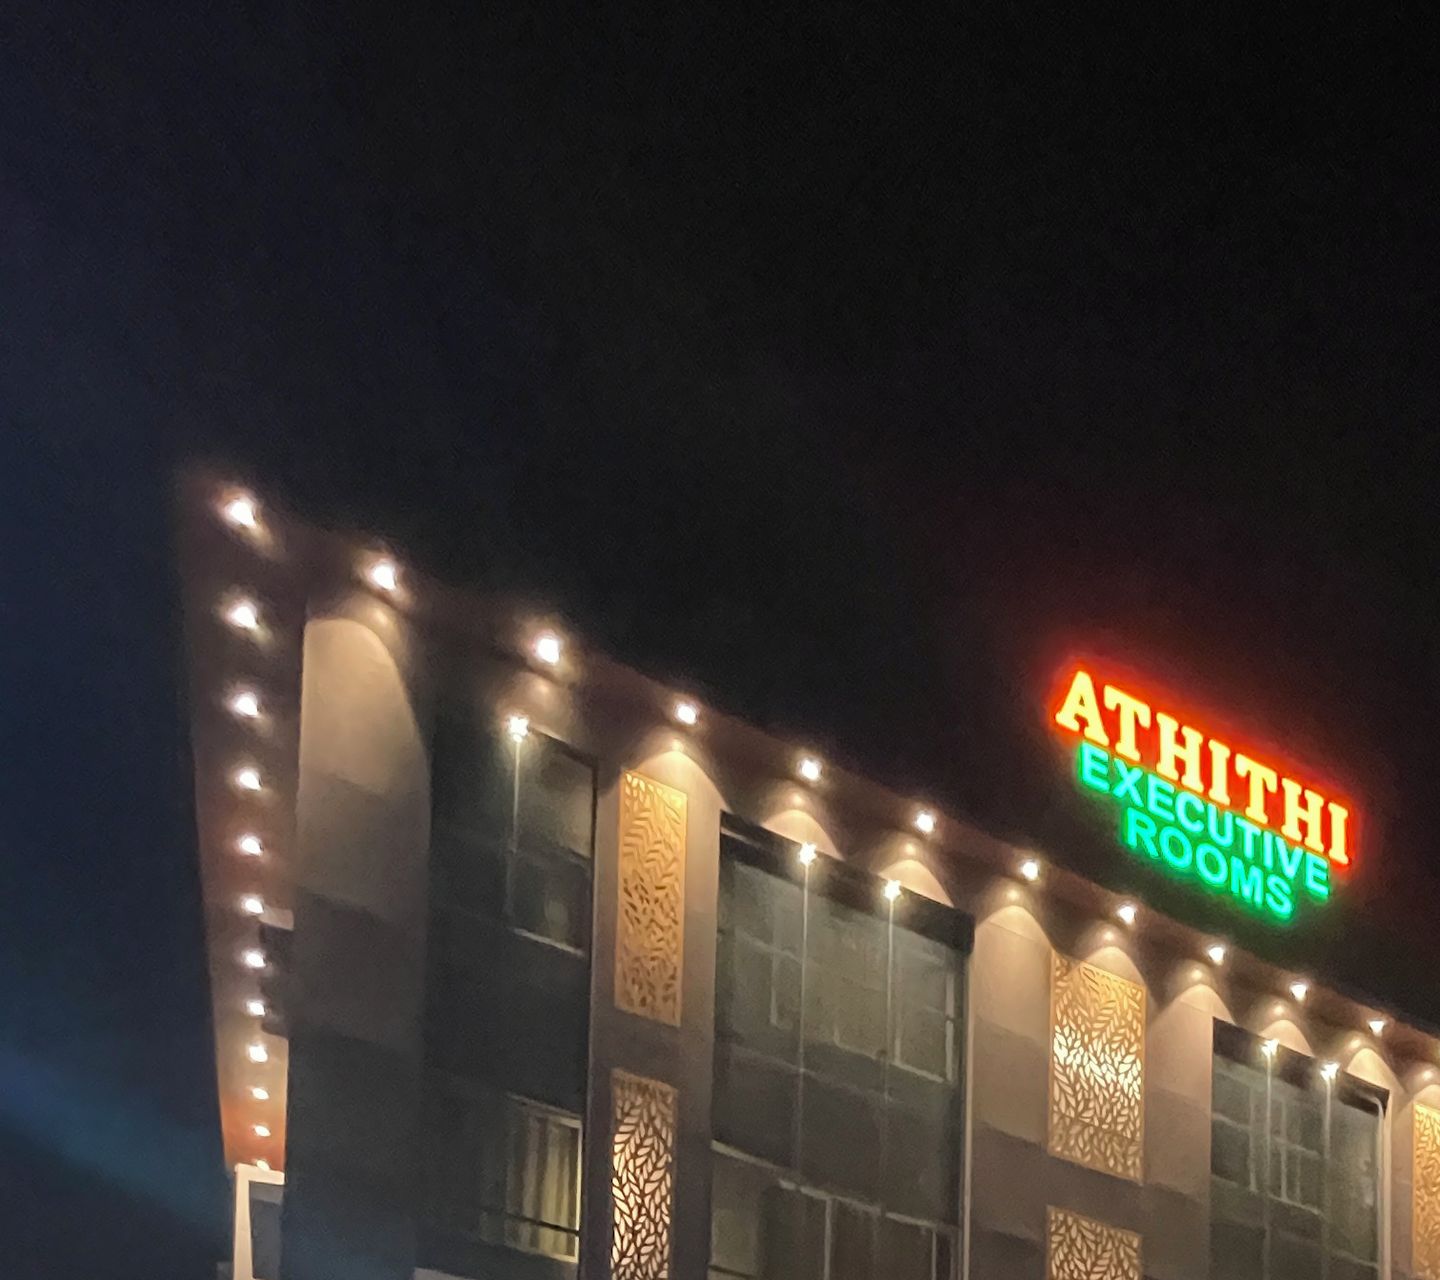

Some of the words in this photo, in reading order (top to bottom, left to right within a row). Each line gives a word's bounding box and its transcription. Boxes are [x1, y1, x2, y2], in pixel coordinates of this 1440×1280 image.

[1056, 671, 1350, 864] ATHITHI
[1079, 741, 1330, 898] EXECUTIVE
[1125, 807, 1293, 917] ROOMS
